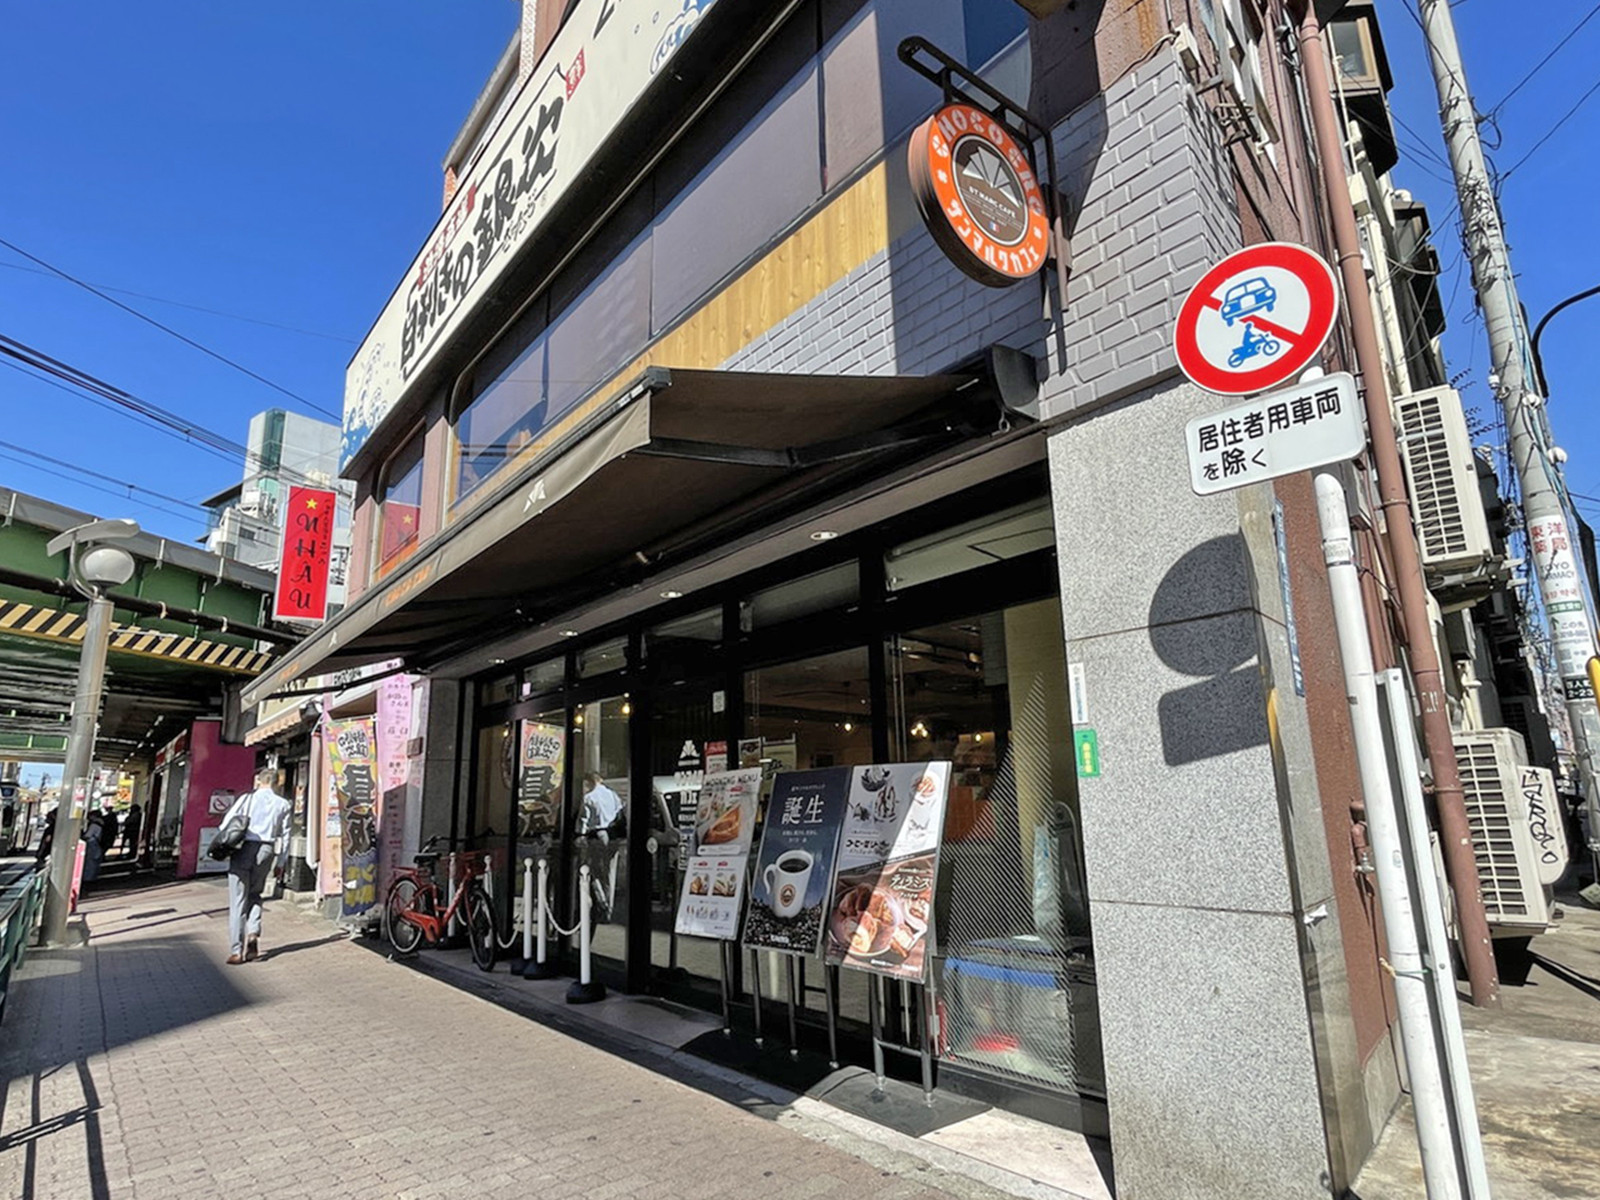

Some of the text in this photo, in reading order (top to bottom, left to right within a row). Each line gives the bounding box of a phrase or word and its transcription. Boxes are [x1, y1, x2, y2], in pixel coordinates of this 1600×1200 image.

[402, 97, 564, 363] 目利きの銀次
[947, 199, 1040, 273] サンマルクカフェ
[1199, 387, 1341, 453] 居住者用車両
[1203, 448, 1267, 481] を除く
[781, 794, 824, 825] 誕生
